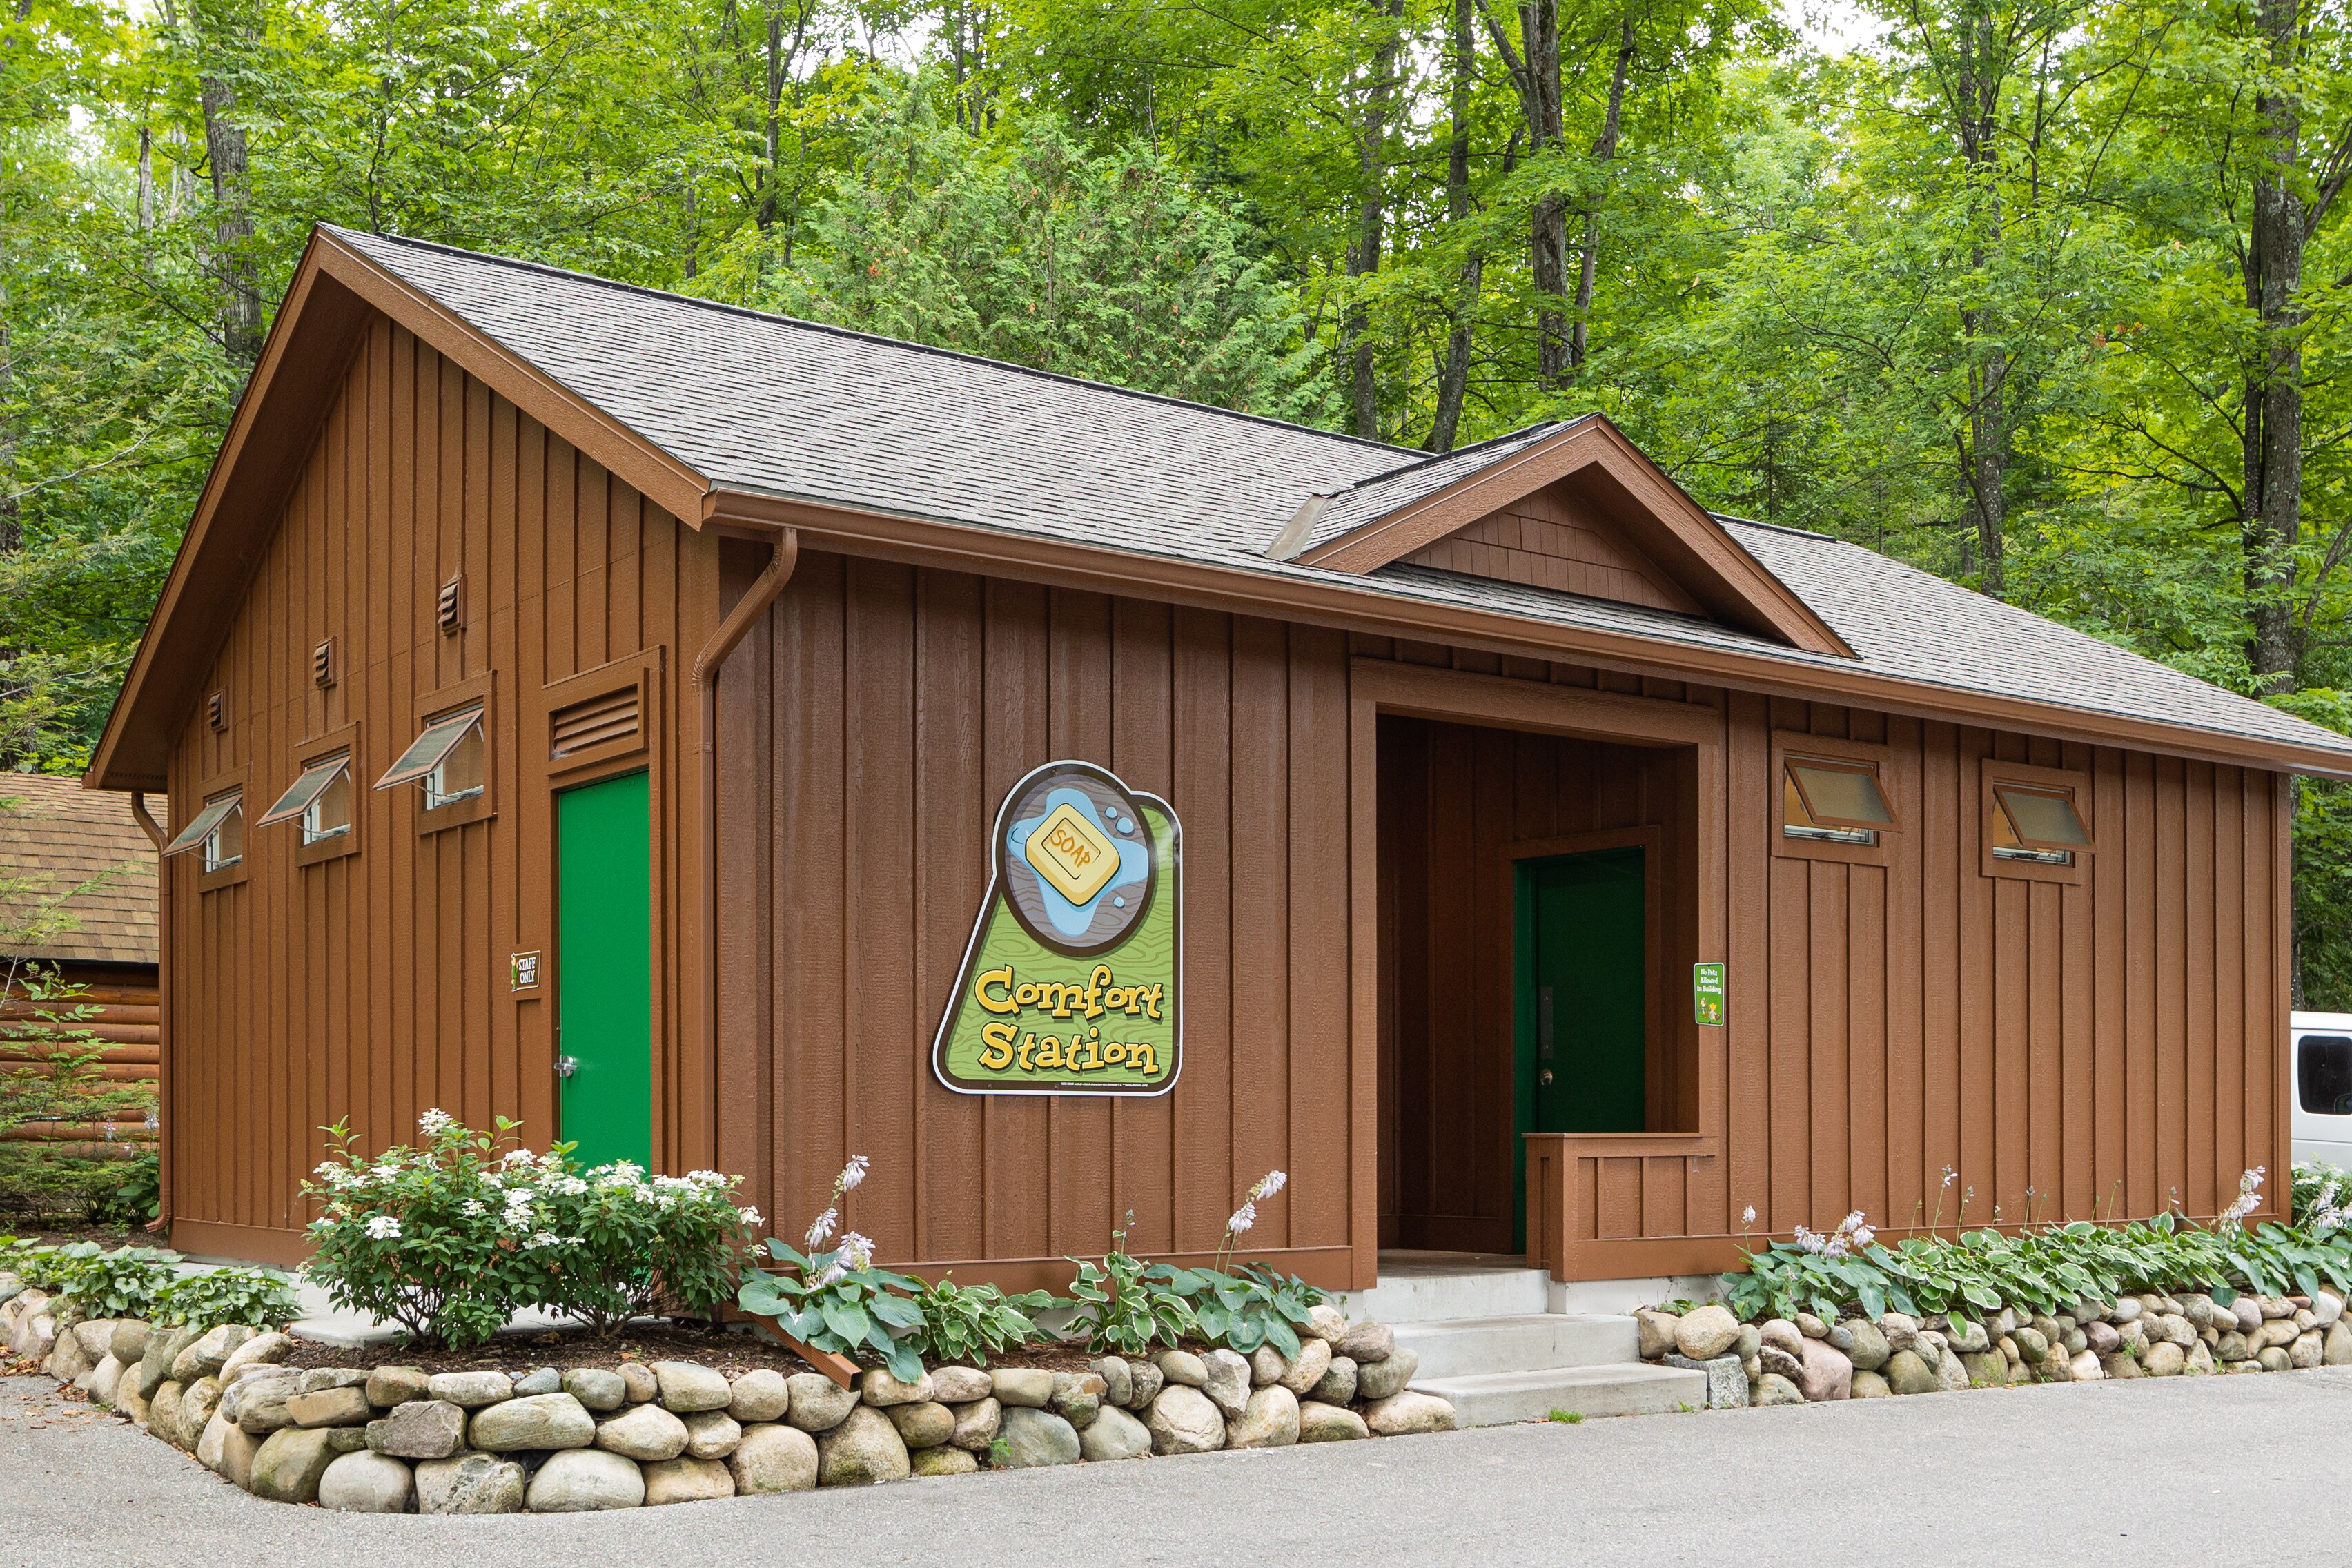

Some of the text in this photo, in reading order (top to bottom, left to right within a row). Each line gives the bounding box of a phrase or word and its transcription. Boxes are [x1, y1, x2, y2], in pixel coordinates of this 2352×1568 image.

[1050, 829, 1092, 868] SOAP
[519, 957, 536, 971] STAFF
[520, 970, 535, 984] ONLY
[1707, 968, 1717, 977] Pets
[974, 964, 1164, 1019] Comfort
[1703, 985, 1721, 994] Building
[978, 1021, 1159, 1073] Station
